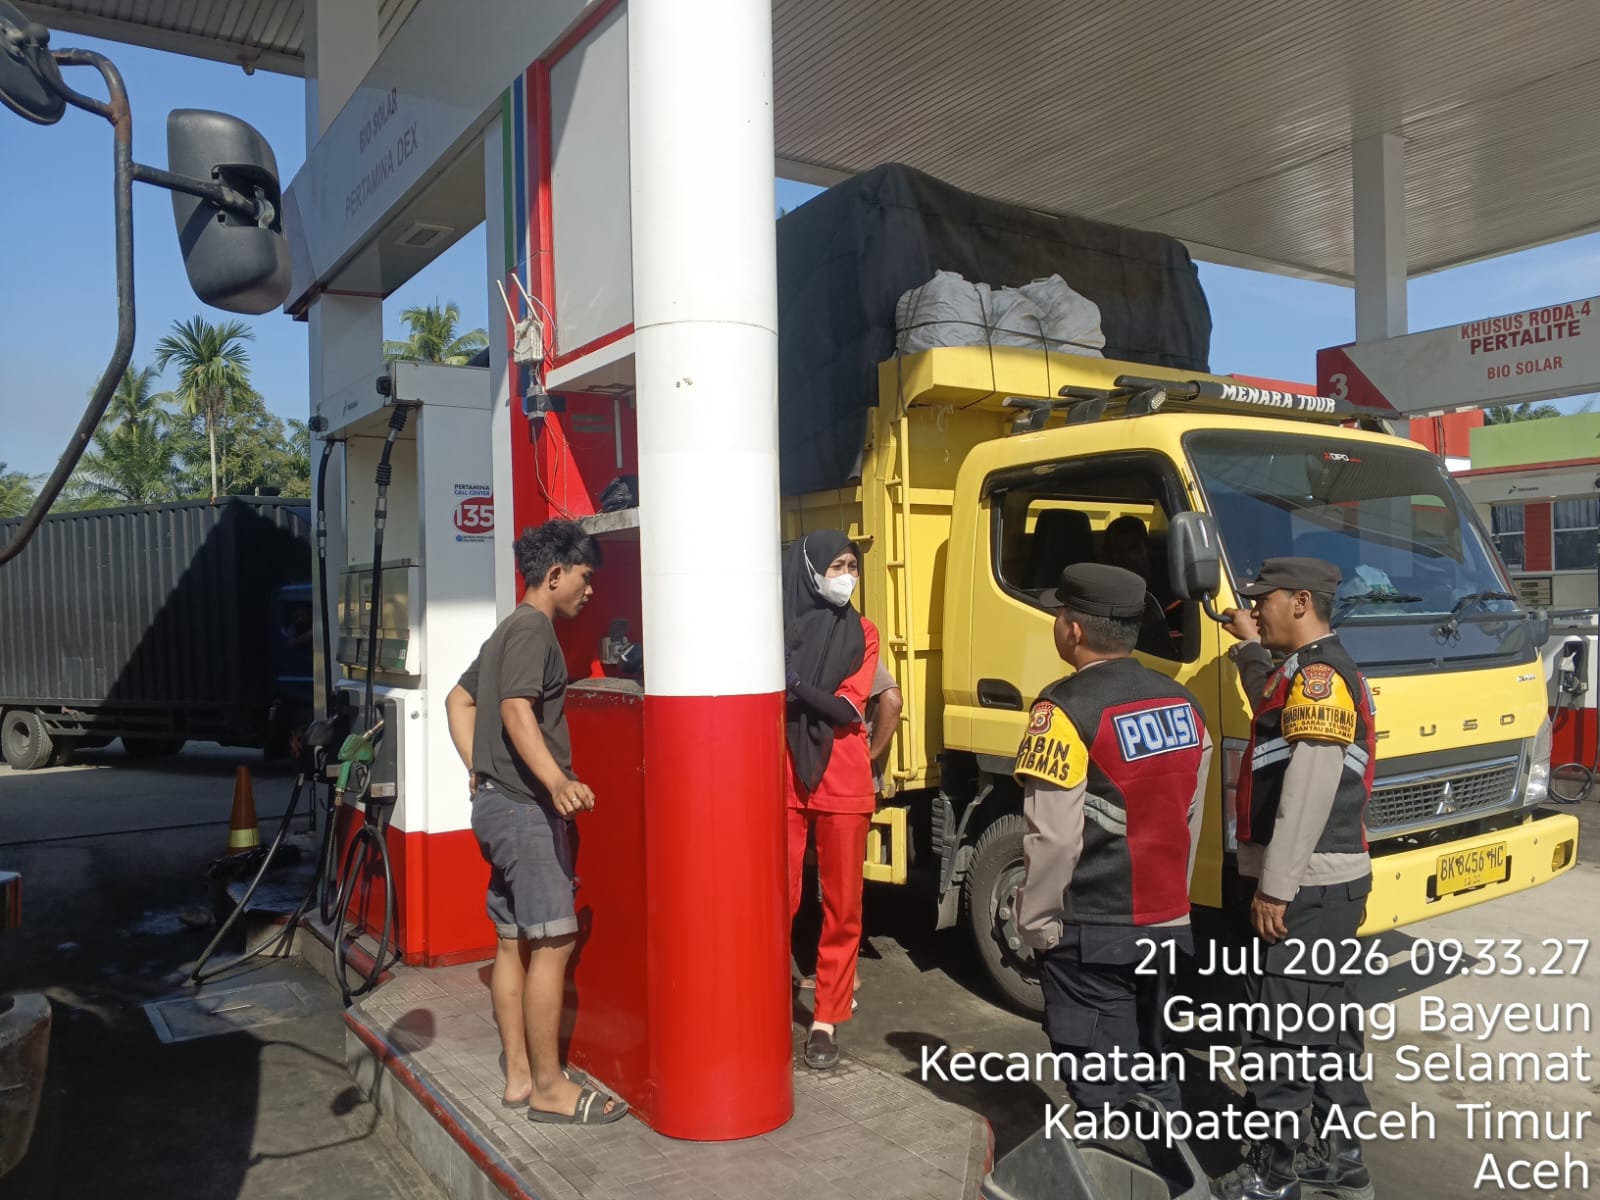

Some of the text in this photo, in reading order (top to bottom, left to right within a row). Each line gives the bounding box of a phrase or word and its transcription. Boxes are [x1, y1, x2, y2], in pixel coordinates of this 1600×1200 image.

[359, 87, 398, 153] BIO SOLAR
[345, 121, 418, 219] PERTAMINA DEX
[1461, 315, 1523, 340] KHUSUS
[1470, 319, 1581, 354] PERTALITE
[1487, 356, 1563, 380] BIO SOLAR
[1219, 383, 1337, 414] MENARA TOUR
[1329, 373, 1349, 400] 3
[456, 504, 494, 528] 135
[1118, 706, 1197, 758] POLISI
[1376, 713, 1516, 743] FUSO
[1440, 857, 1455, 880] BK
[1456, 850, 1485, 876] 8456
